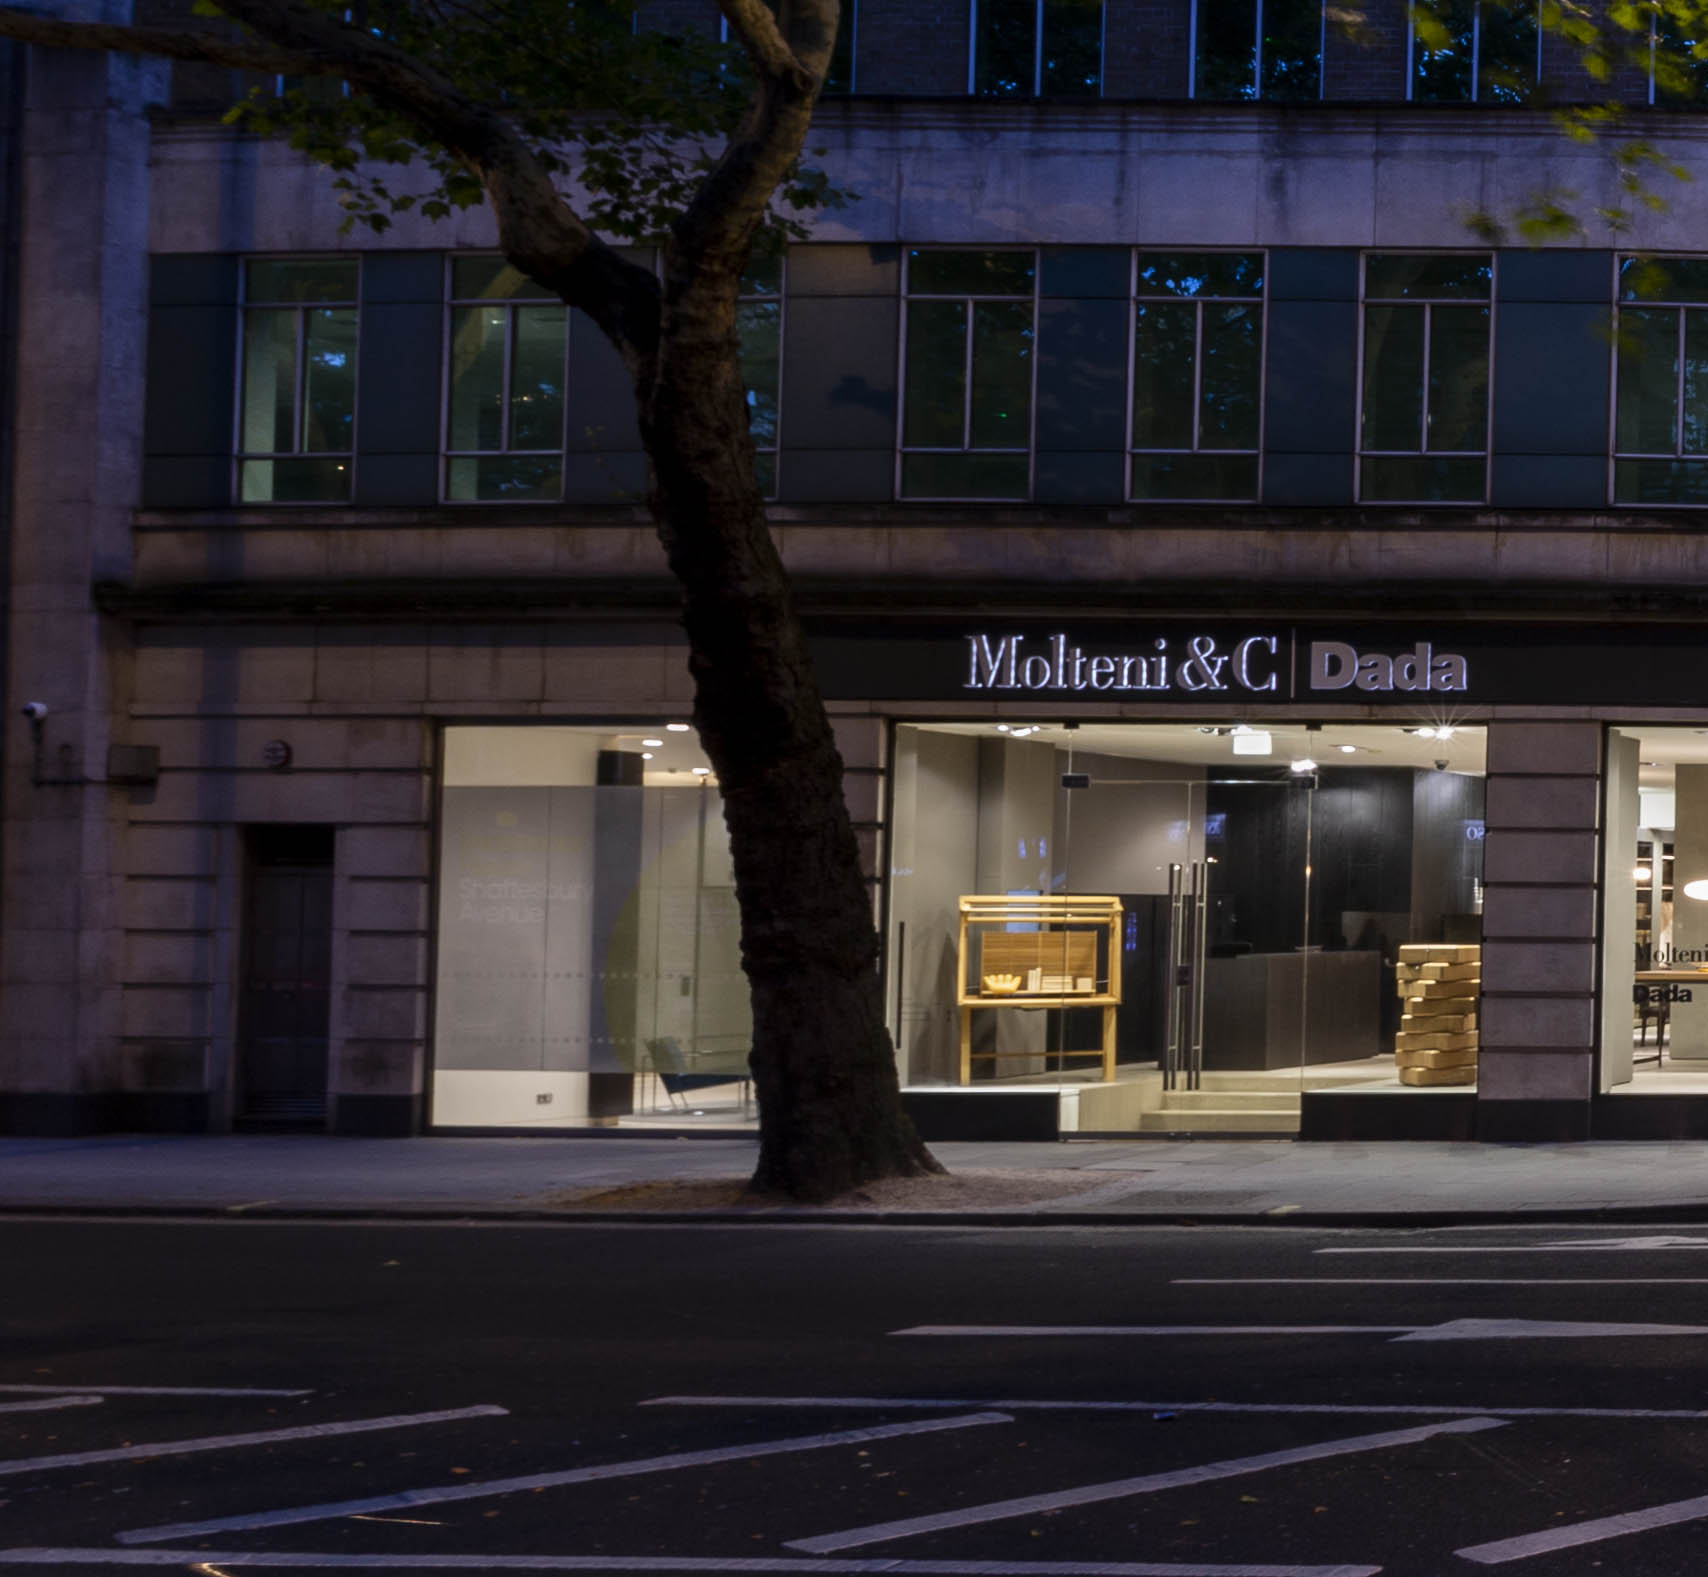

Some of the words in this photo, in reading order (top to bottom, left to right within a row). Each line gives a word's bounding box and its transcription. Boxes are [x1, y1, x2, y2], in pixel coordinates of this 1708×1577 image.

[962, 632, 1278, 692] Molteni&C
[1309, 641, 1469, 693] Dada
[1633, 983, 1693, 1003] Dada
